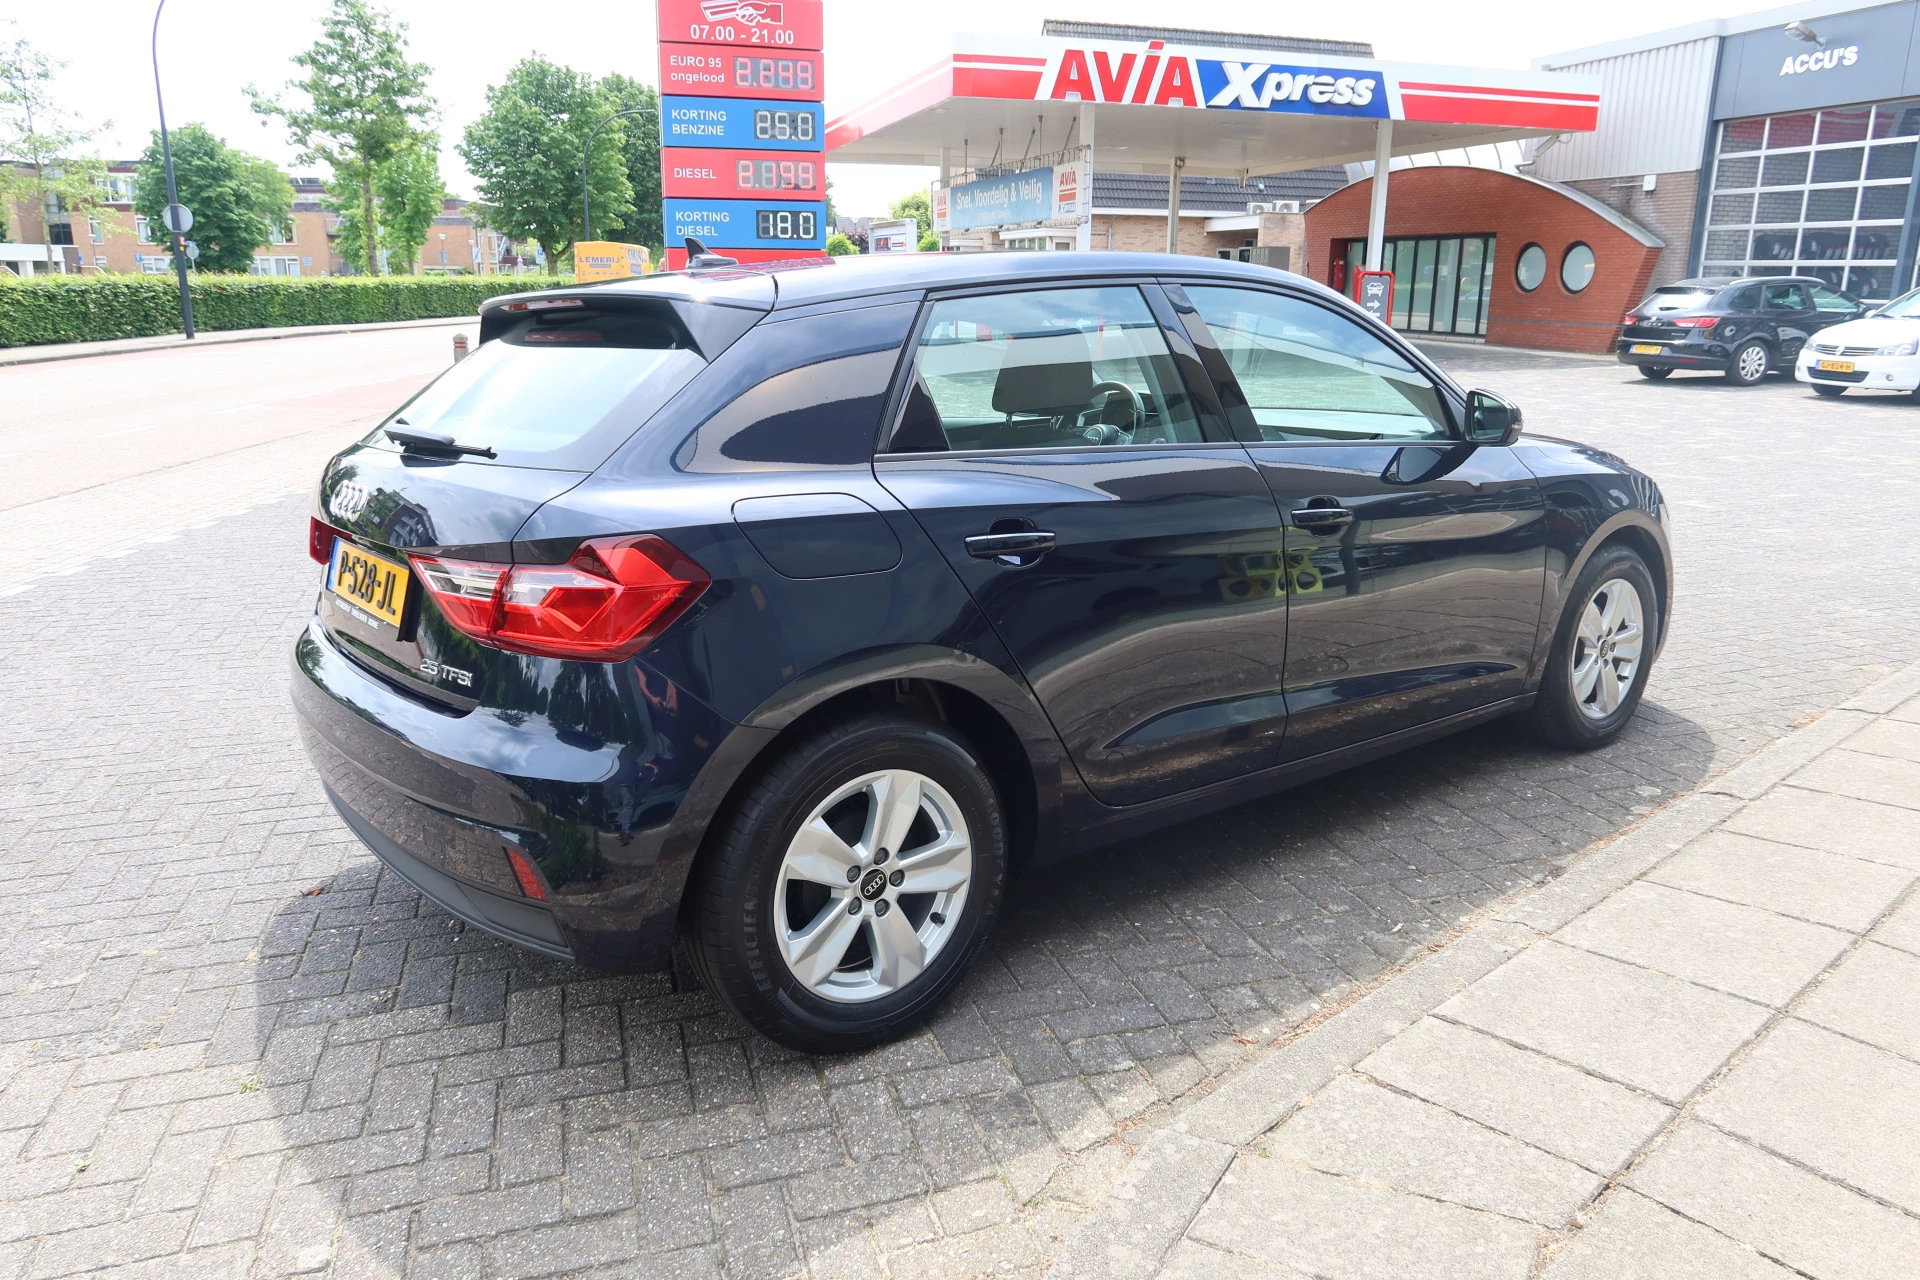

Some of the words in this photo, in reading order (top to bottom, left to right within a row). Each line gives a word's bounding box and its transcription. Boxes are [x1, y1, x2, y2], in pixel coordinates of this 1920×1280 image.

[690, 24, 735, 41] 07.00
[751, 29, 795, 44] 21.00
[670, 55, 705, 67] EURO
[709, 57, 722, 68] 95
[735, 57, 813, 89] 2.249
[1779, 45, 1859, 77] ACCU'S
[670, 72, 725, 84] ongelood
[1207, 61, 1376, 108] Xpress
[671, 109, 727, 121] KORTING
[672, 124, 725, 136] BENZINE
[674, 168, 717, 179] DIESEL
[738, 160, 813, 190] 2.199
[974, 183, 1009, 208] Voordelig
[1011, 182, 1017, 202] &
[1019, 178, 1043, 203] Veilig
[676, 211, 730, 222] KORTING
[769, 211, 814, 239] 18.0
[676, 225, 718, 236] DIESEL
[338, 551, 397, 616] P-528-JL
[420, 658, 439, 675] 25
[441, 664, 473, 687] TFSI
